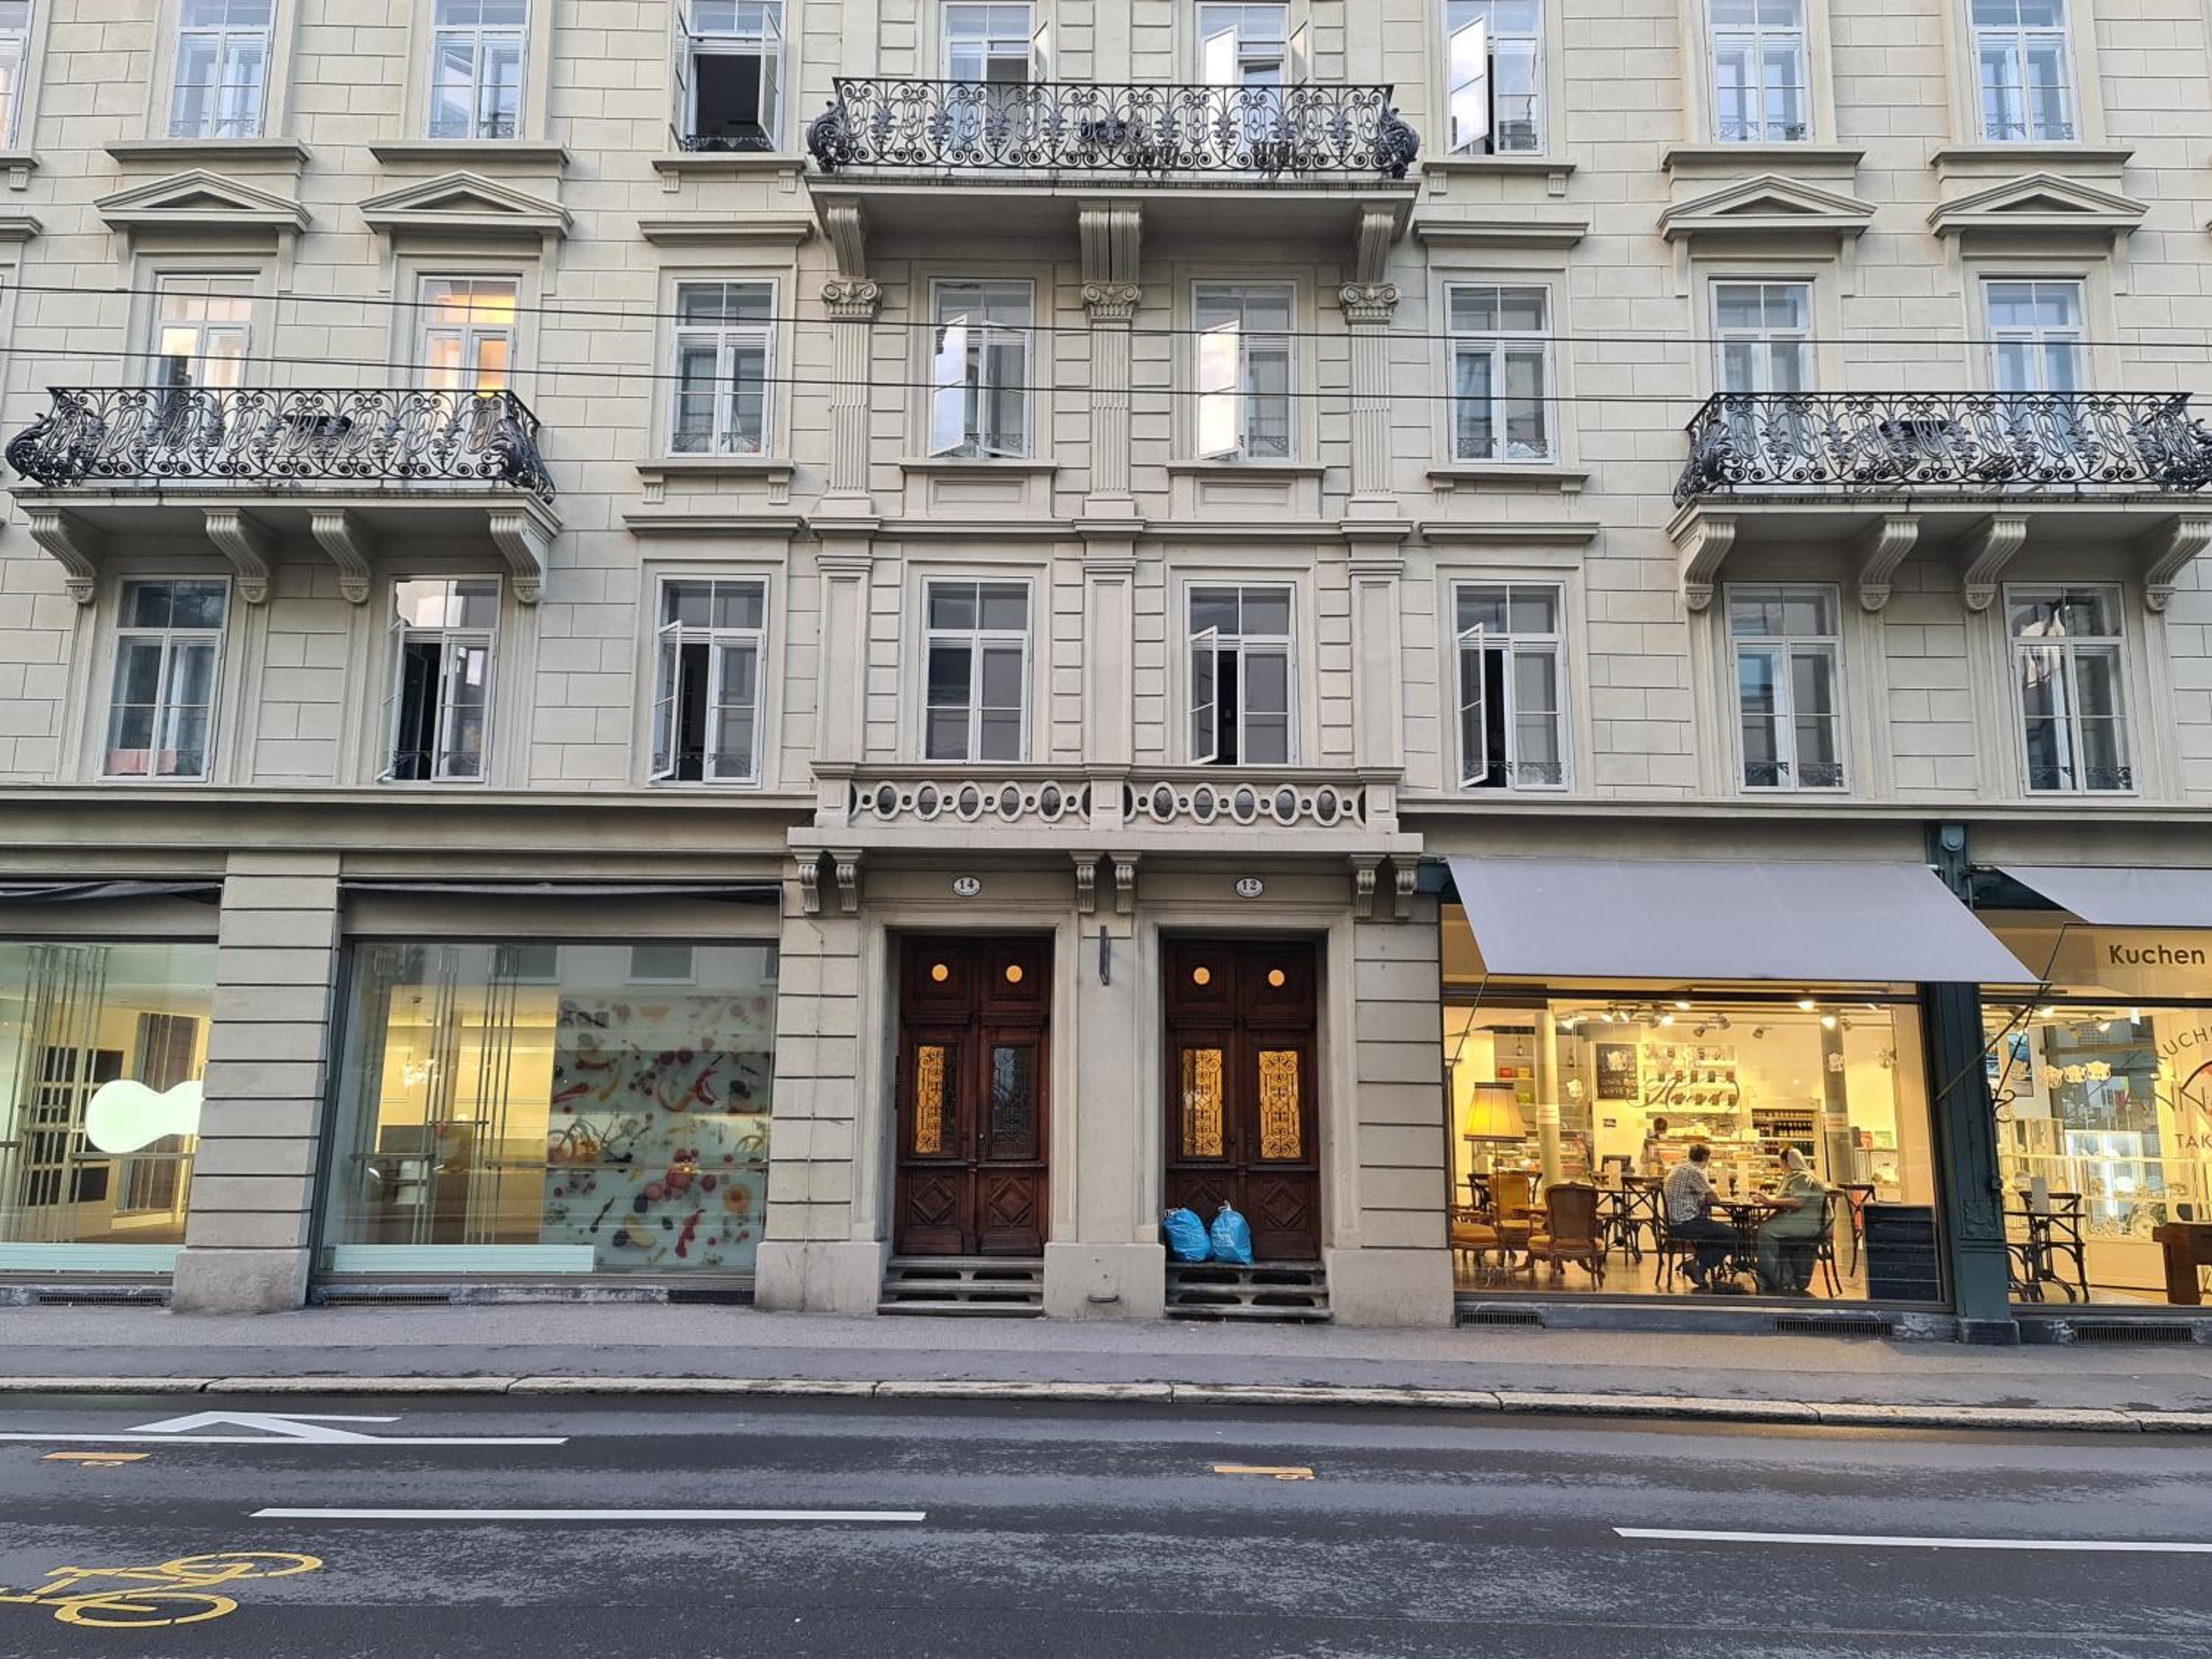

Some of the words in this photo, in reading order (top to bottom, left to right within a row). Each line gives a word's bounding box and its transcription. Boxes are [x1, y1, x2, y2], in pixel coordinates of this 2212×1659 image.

[960, 879, 975, 889] 14
[1242, 880, 1257, 890] 12
[2110, 945, 2205, 964] Kuchen
